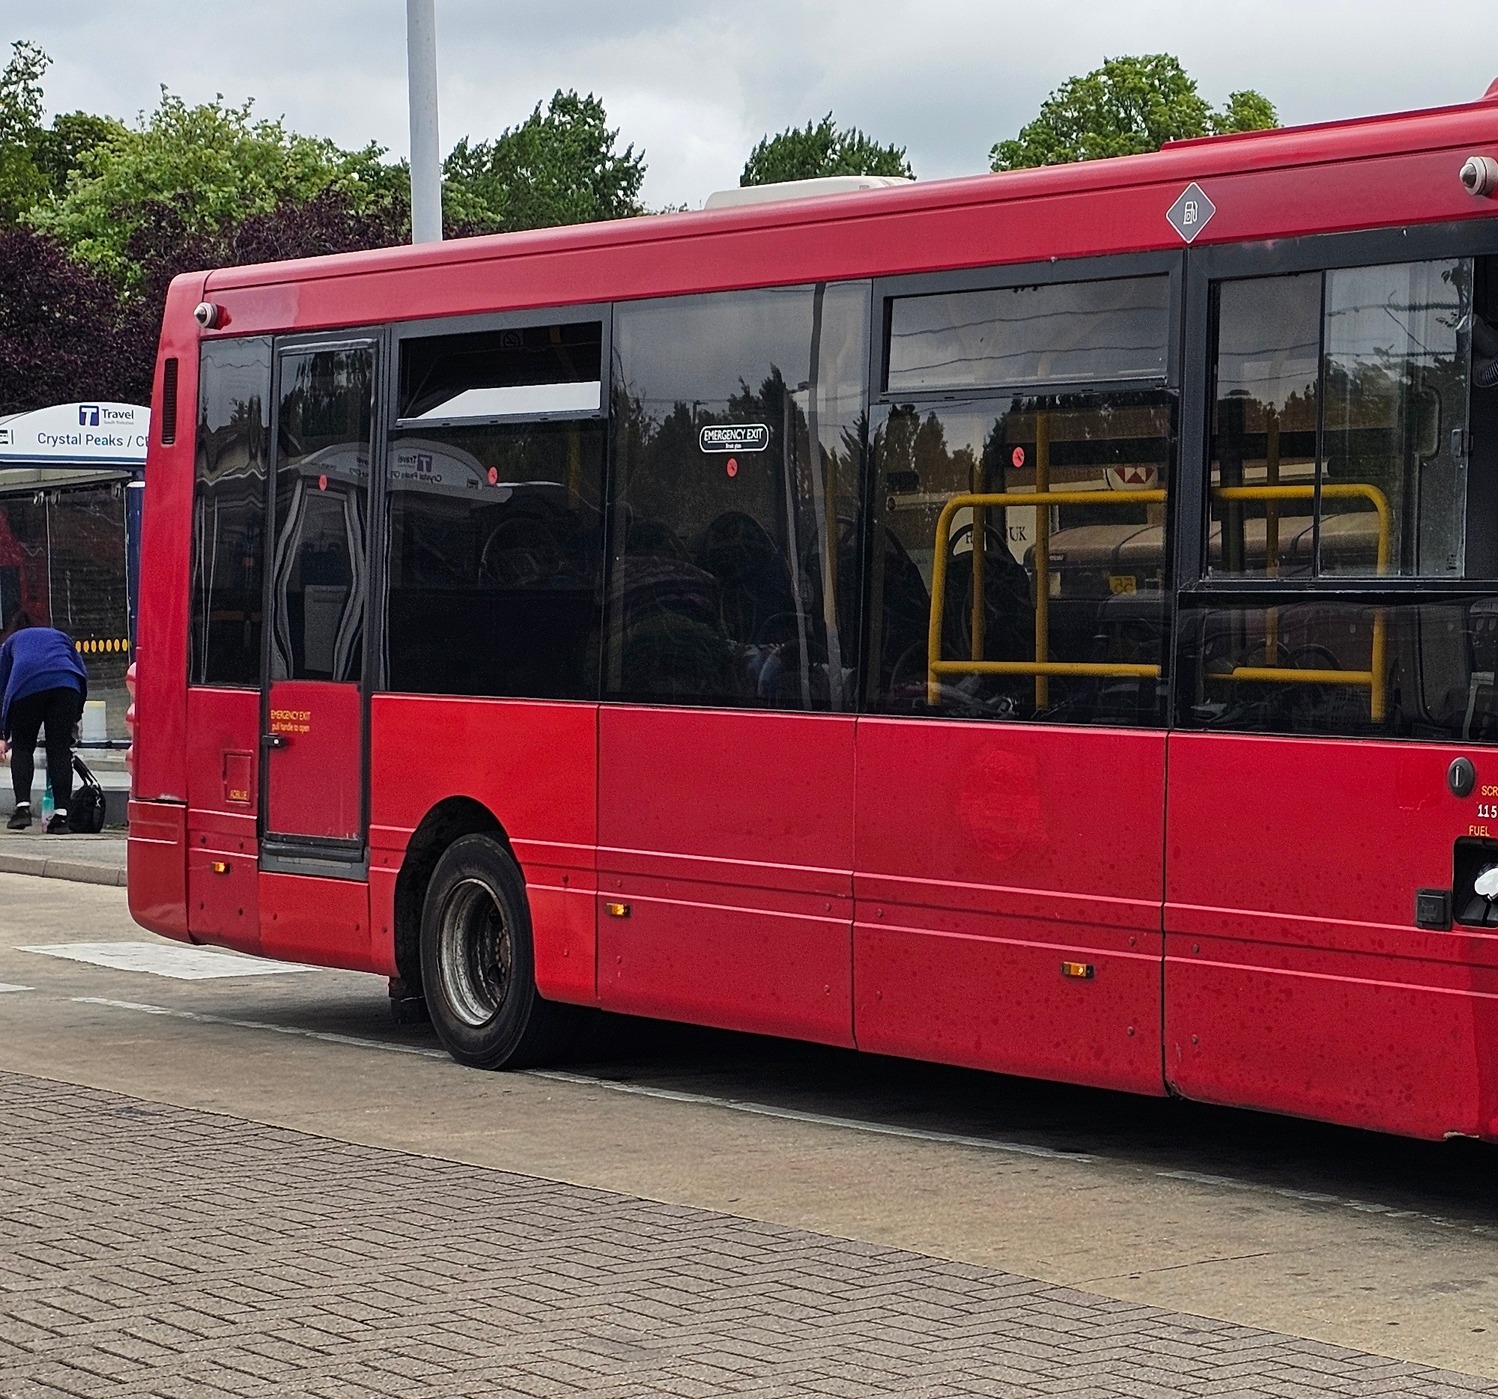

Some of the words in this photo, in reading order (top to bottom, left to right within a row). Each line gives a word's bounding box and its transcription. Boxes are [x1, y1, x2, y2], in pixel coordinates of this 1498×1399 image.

[102, 409, 134, 419] Travel
[37, 433, 82, 447] Crystal
[86, 434, 123, 447] Peaks
[704, 429, 745, 441] EMERGENCY
[746, 428, 764, 439] EXIT
[271, 710, 298, 720] EMERGENCY
[299, 711, 311, 721] EXIT
[1468, 825, 1491, 837] FUEL
